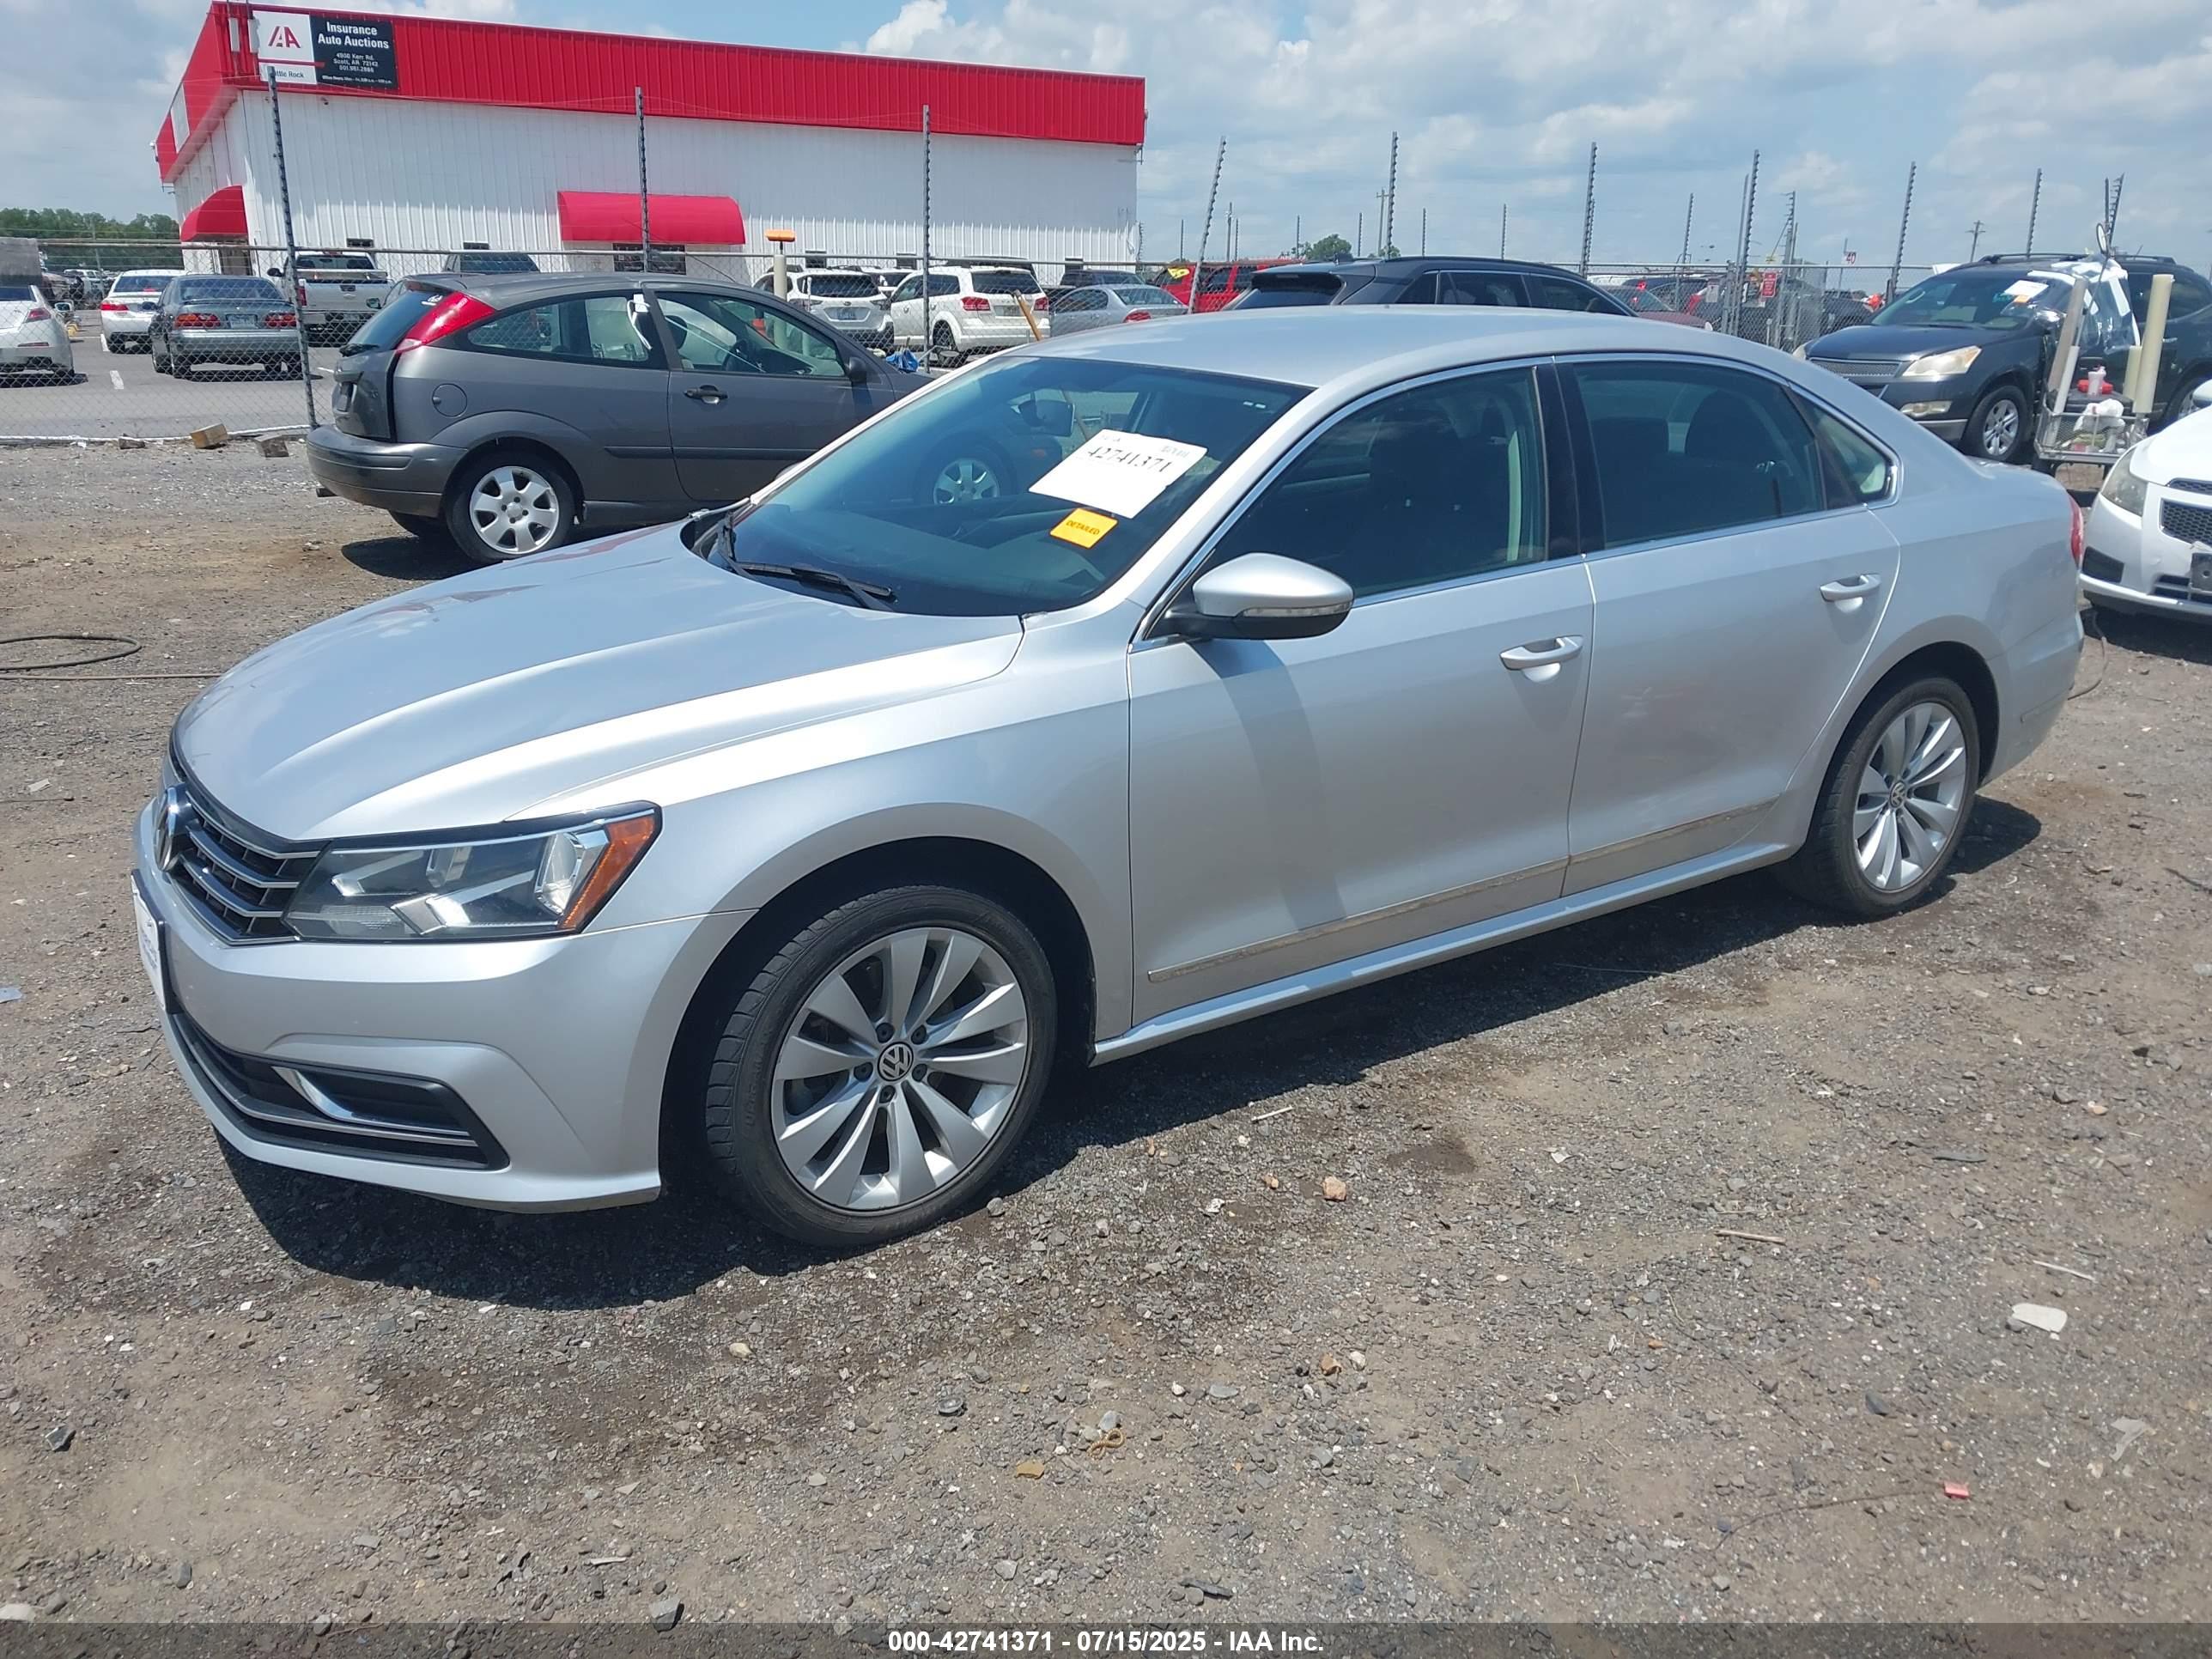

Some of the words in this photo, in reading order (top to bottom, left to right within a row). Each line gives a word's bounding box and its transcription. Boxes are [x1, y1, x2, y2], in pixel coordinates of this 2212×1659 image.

[326, 21, 378, 35] Insurance
[318, 33, 342, 45] Auto
[344, 35, 389, 49] Auctions
[1088, 447, 1173, 473] 42741371
[1066, 520, 1100, 535] DETAILED
